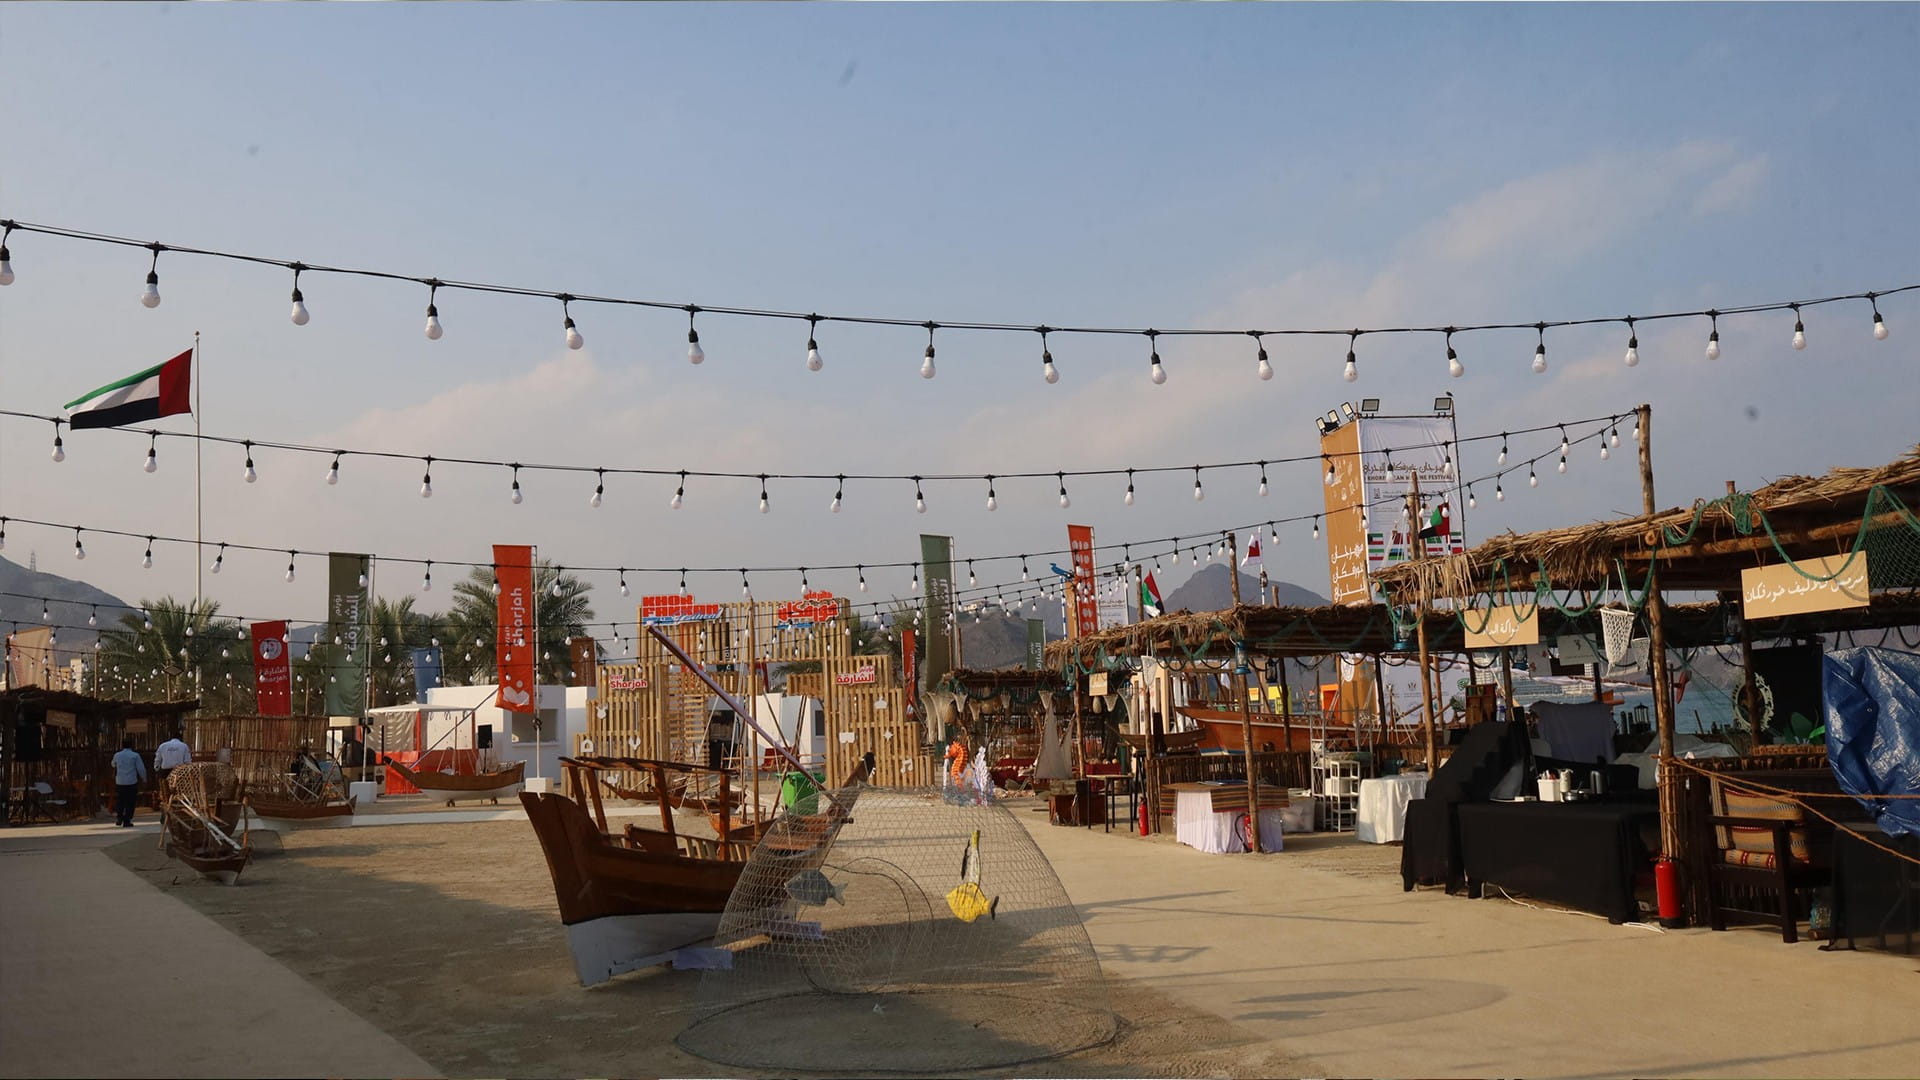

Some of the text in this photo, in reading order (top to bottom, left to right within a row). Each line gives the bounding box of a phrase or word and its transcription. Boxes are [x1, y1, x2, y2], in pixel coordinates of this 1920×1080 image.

[643, 594, 693, 606] KHOR
[778, 601, 838, 622] خورفكان
[344, 595, 360, 651] الشارقة
[610, 680, 646, 689] Sharjah
[836, 672, 874, 685] الشارقة
